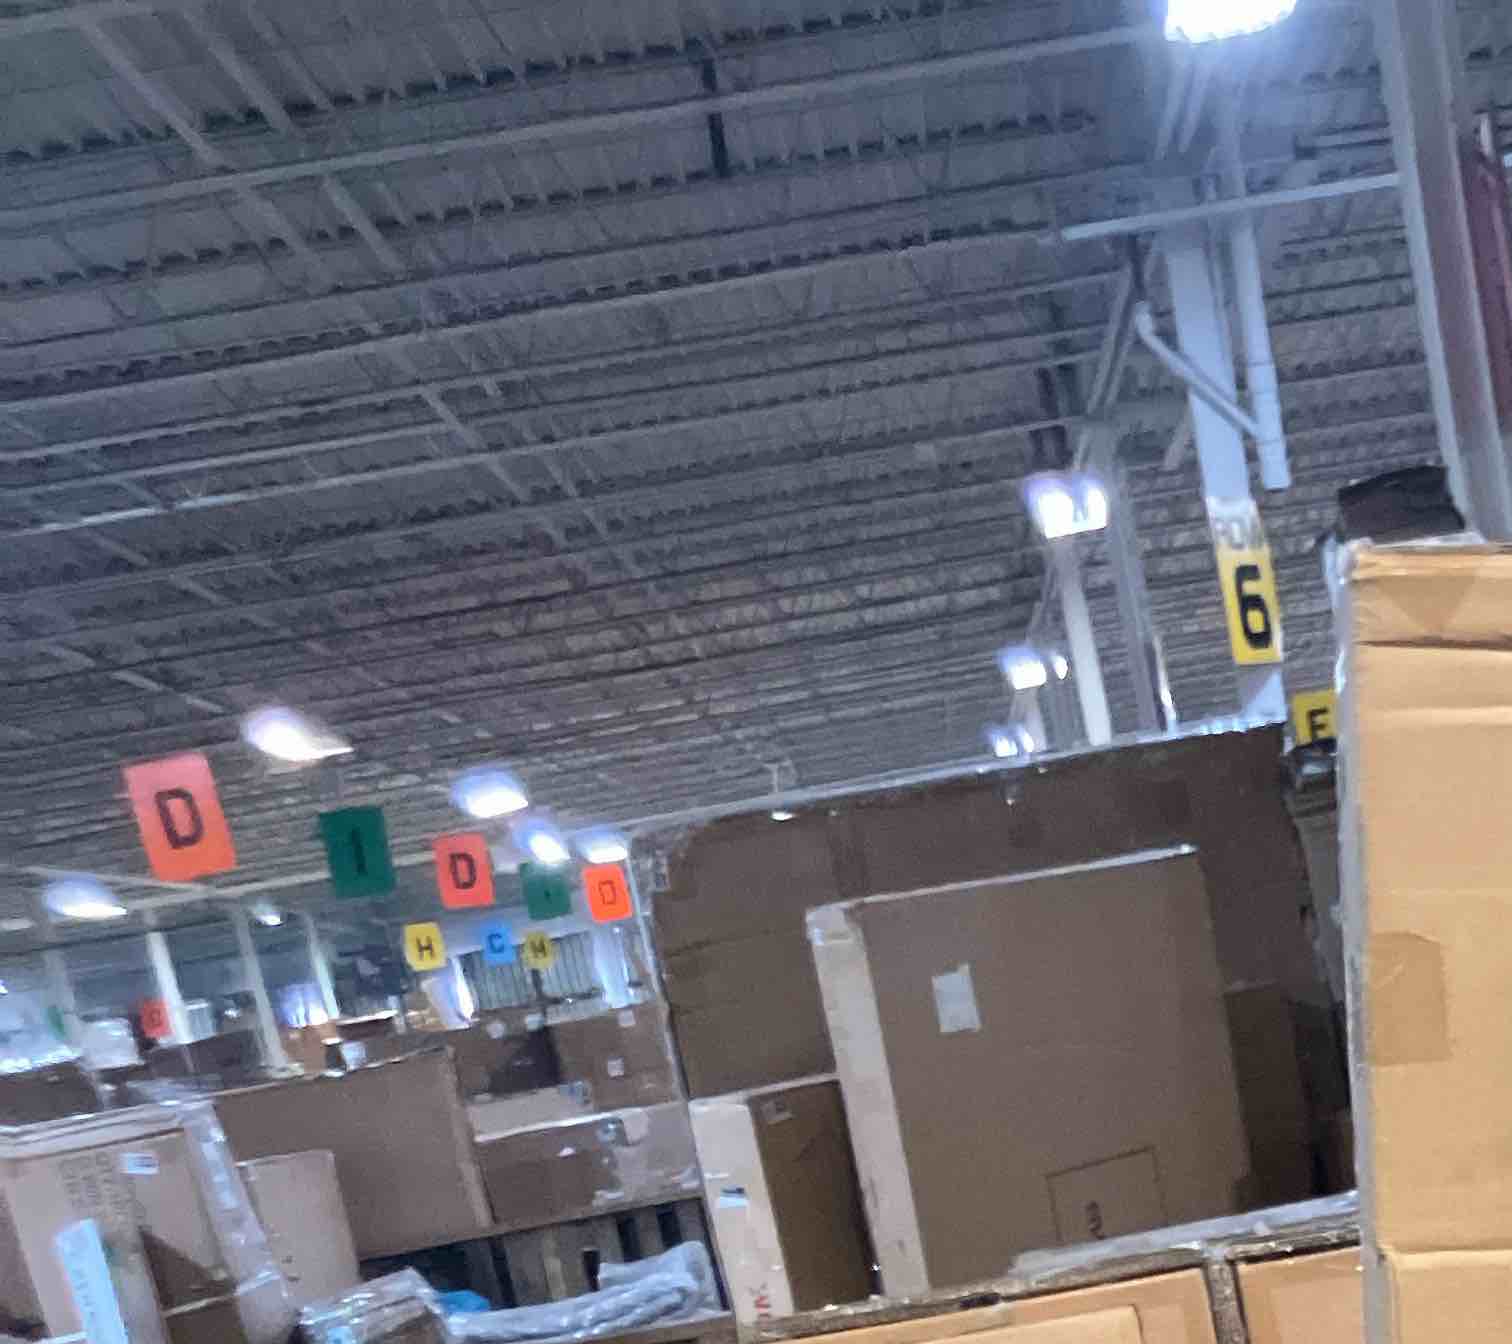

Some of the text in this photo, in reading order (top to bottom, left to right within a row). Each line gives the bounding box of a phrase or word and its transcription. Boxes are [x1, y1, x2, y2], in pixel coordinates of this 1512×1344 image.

[1235, 564, 1272, 649] 6
[154, 788, 204, 850] D
[450, 852, 477, 890] D
[416, 934, 435, 961] H
[487, 932, 506, 954] C
